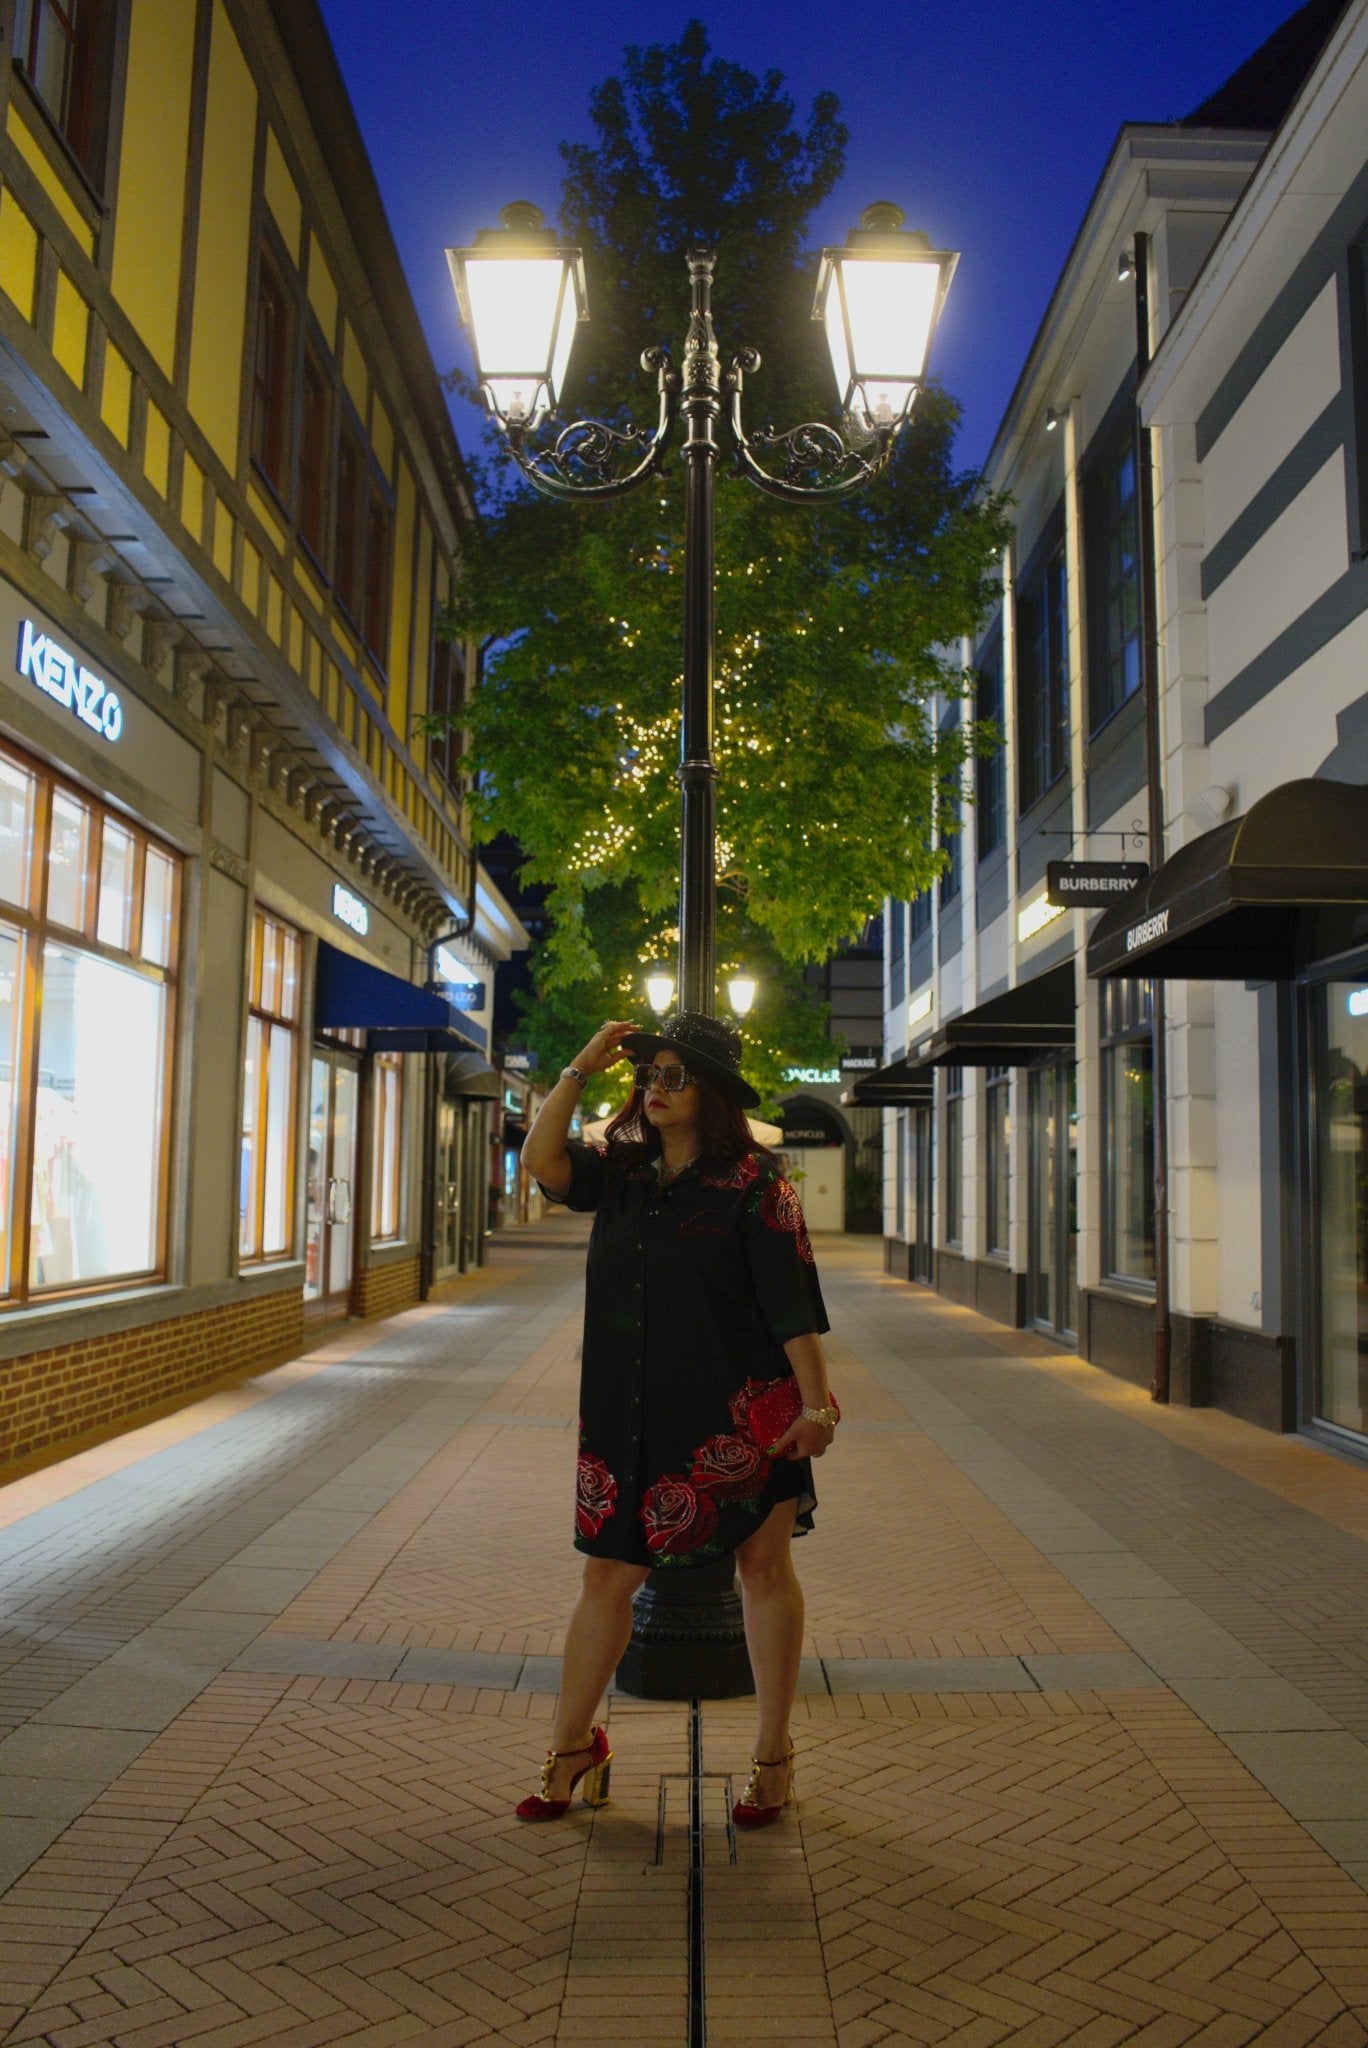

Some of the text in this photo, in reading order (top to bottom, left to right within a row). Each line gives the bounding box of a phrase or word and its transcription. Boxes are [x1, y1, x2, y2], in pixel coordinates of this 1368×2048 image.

[20, 620, 122, 741] KENZO
[1059, 878, 1138, 891] BURBERRY
[1126, 910, 1169, 952] BURBERRY
